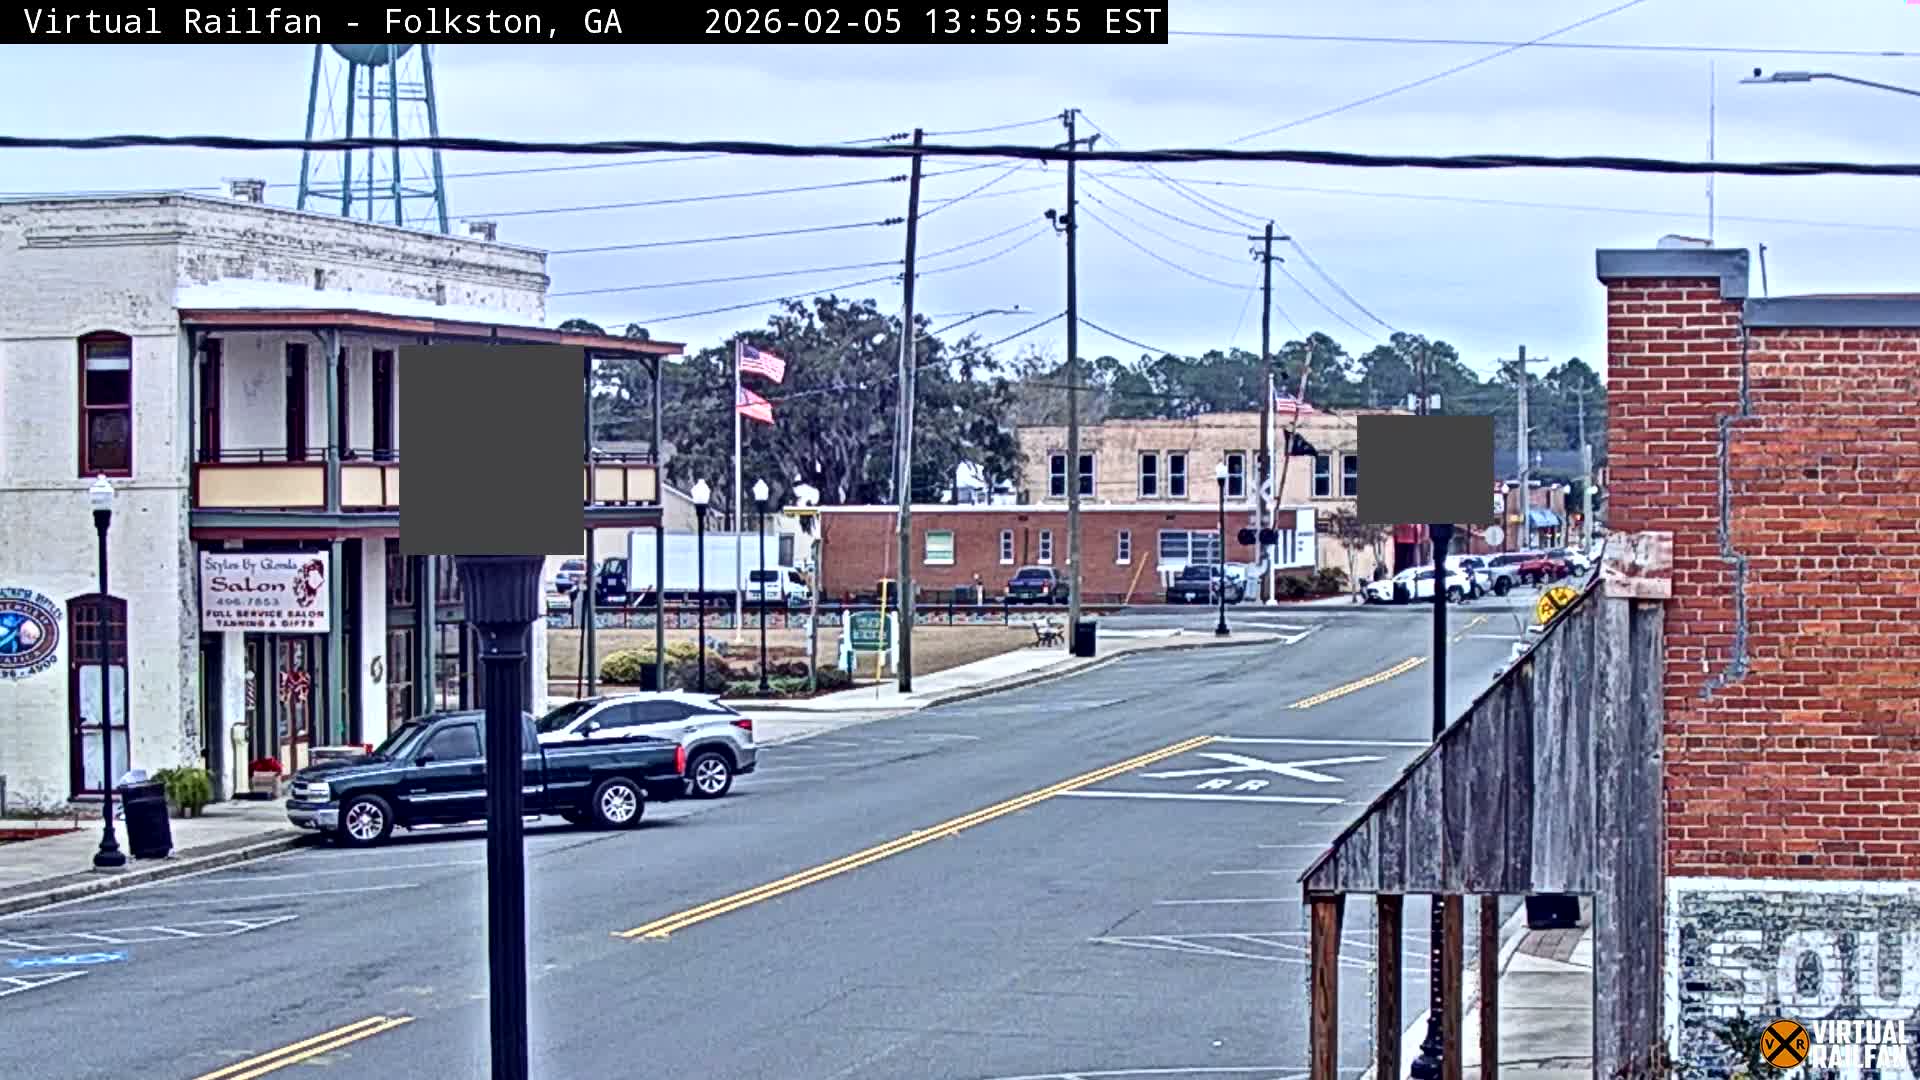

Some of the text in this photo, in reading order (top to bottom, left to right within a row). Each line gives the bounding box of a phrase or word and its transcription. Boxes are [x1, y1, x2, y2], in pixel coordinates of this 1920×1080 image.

[210, 576, 286, 593] Salon
[206, 610, 325, 618] FULL SERVICE SALON
[216, 619, 265, 627] TANNING
[281, 619, 315, 627] GIFTS
